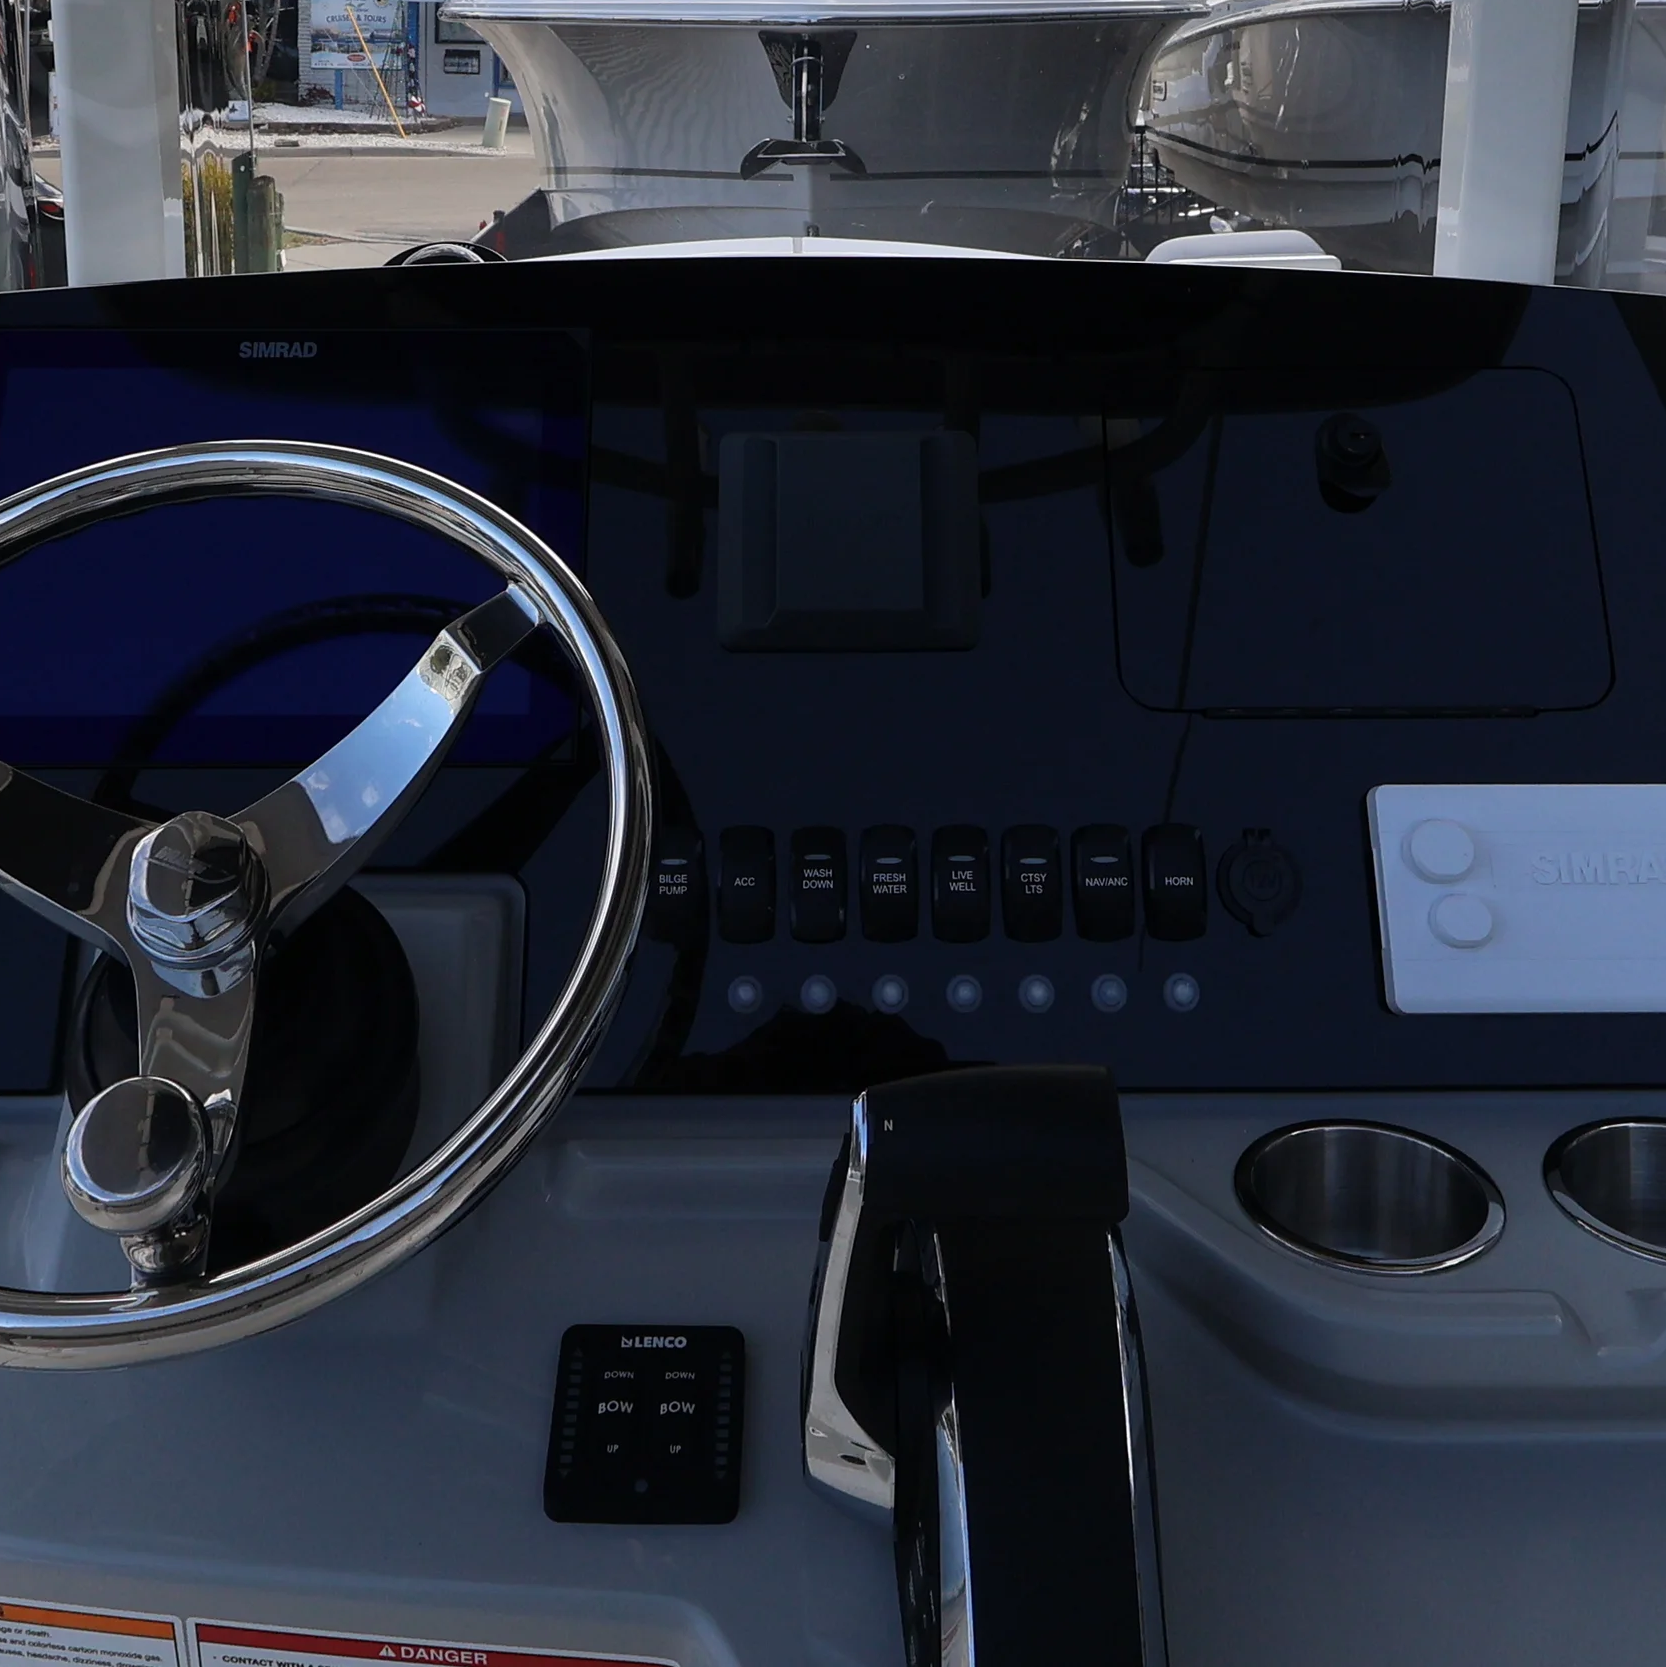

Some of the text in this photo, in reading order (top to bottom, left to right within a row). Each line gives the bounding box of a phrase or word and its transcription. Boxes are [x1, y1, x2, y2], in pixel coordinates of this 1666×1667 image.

[326, 14, 351, 23] CRUISE
[364, 14, 387, 23] TOURS
[238, 341, 318, 359] SIMRAD
[803, 869, 833, 878] WASH
[873, 873, 906, 883] FRESH
[952, 871, 973, 880] LIVE
[1020, 873, 1047, 883] CTSY
[659, 874, 688, 884] BILGE
[734, 877, 755, 887] ACC
[802, 879, 834, 889] DOWN
[1085, 877, 1129, 887] NAV/ANC
[1165, 876, 1194, 886] HORN
[659, 886, 688, 895] PUMP
[873, 885, 907, 894] WATER
[949, 882, 976, 892] WELL
[1025, 885, 1043, 894] LTS
[884, 1119, 893, 1132] N
[634, 1336, 688, 1348] LENCO
[604, 1370, 696, 1381] DOWN DOWN
[598, 1400, 696, 1415] BOW BOW
[606, 1444, 682, 1454] UP UP
[9, 1638, 26, 1646] and
[28, 1641, 66, 1651] colorless
[68, 1645, 98, 1654] carbon
[100, 1649, 143, 1659] monoxide
[400, 1646, 488, 1665] DANGER
[222, 1655, 273, 1667] CONTACT
